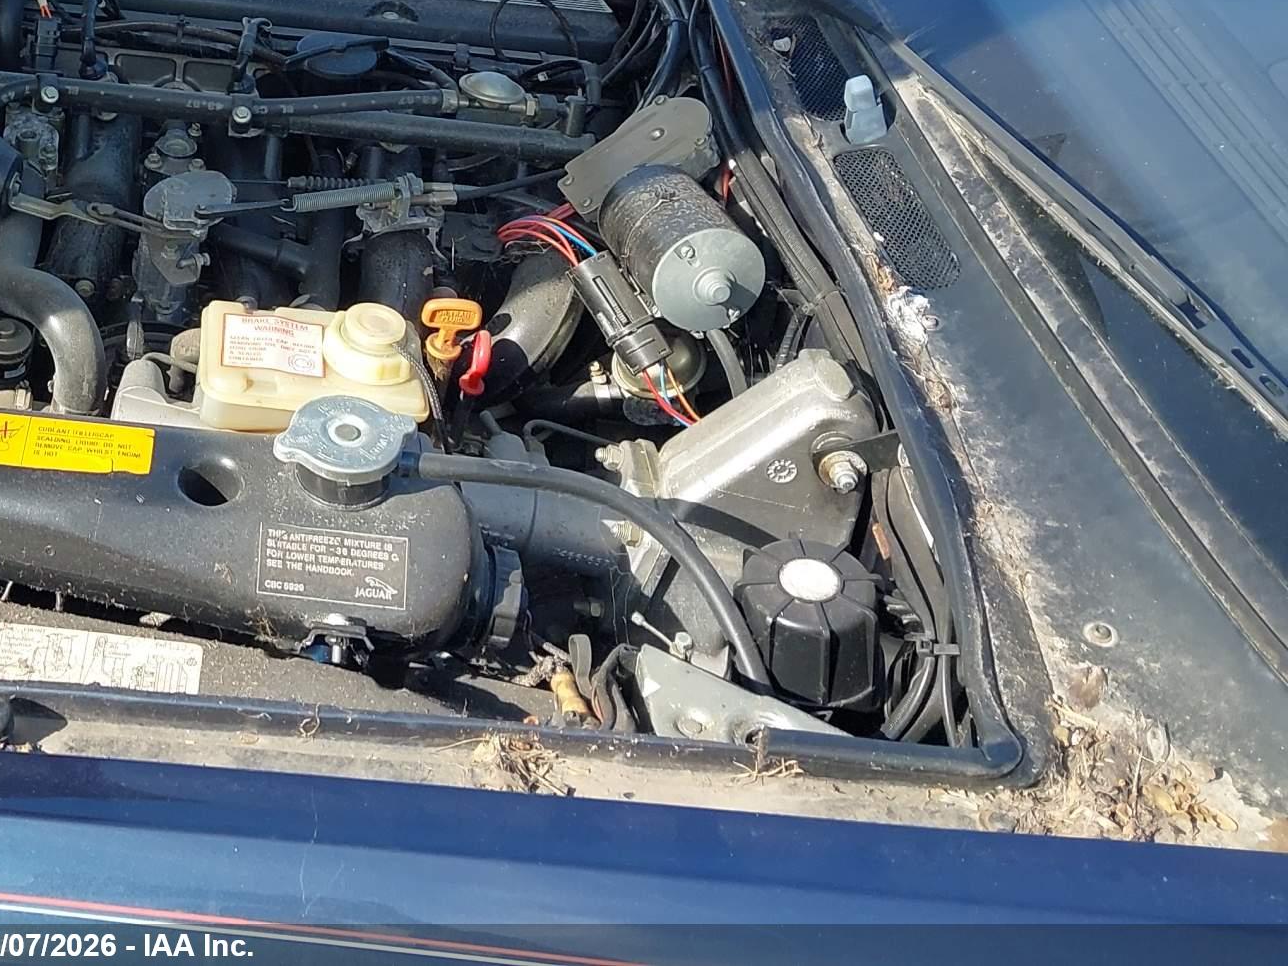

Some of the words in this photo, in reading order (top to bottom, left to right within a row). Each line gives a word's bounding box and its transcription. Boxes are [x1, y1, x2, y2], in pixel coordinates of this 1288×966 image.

[254, 325, 295, 337] WARNING
[273, 319, 309, 331] SYSTEM
[38, 426, 71, 435] COOLANT
[35, 442, 63, 450] REMOVE
[37, 436, 71, 444] SCALDING
[268, 529, 288, 540] THIS
[289, 533, 342, 546] ANTIFREEZE
[343, 537, 382, 550] MIXTURE
[384, 542, 393, 552] IS
[266, 538, 308, 551] SUITABLE
[309, 544, 327, 554] FOR
[350, 548, 389, 561] DEGREES
[266, 547, 284, 559] FOR
[285, 551, 316, 563] LOWER
[266, 558, 283, 569] SEE
[285, 560, 303, 571] THE
[354, 585, 393, 601] JAGUAR
